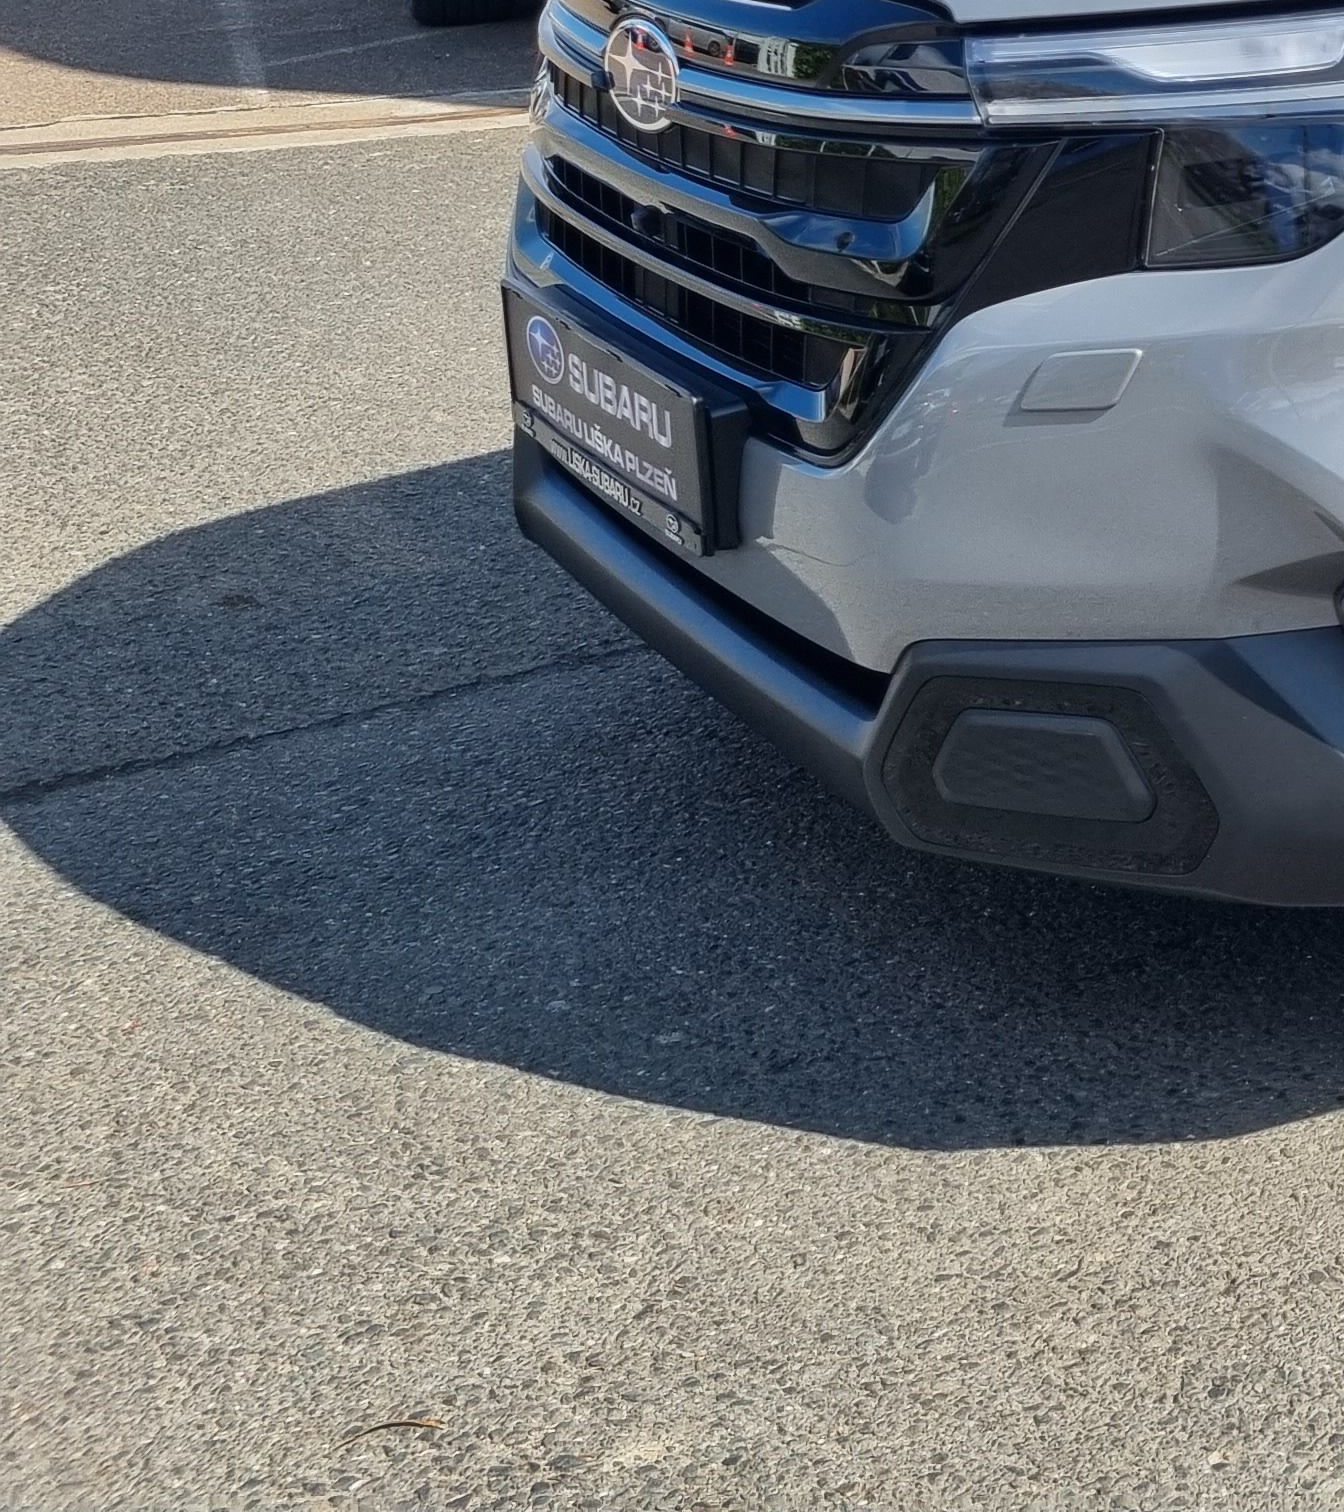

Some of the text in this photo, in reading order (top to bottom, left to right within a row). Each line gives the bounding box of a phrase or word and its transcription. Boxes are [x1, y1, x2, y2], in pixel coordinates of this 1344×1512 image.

[531, 384, 678, 502] SUBARU LIŠKA PLZEŇ
[568, 353, 672, 449] SUBARU
